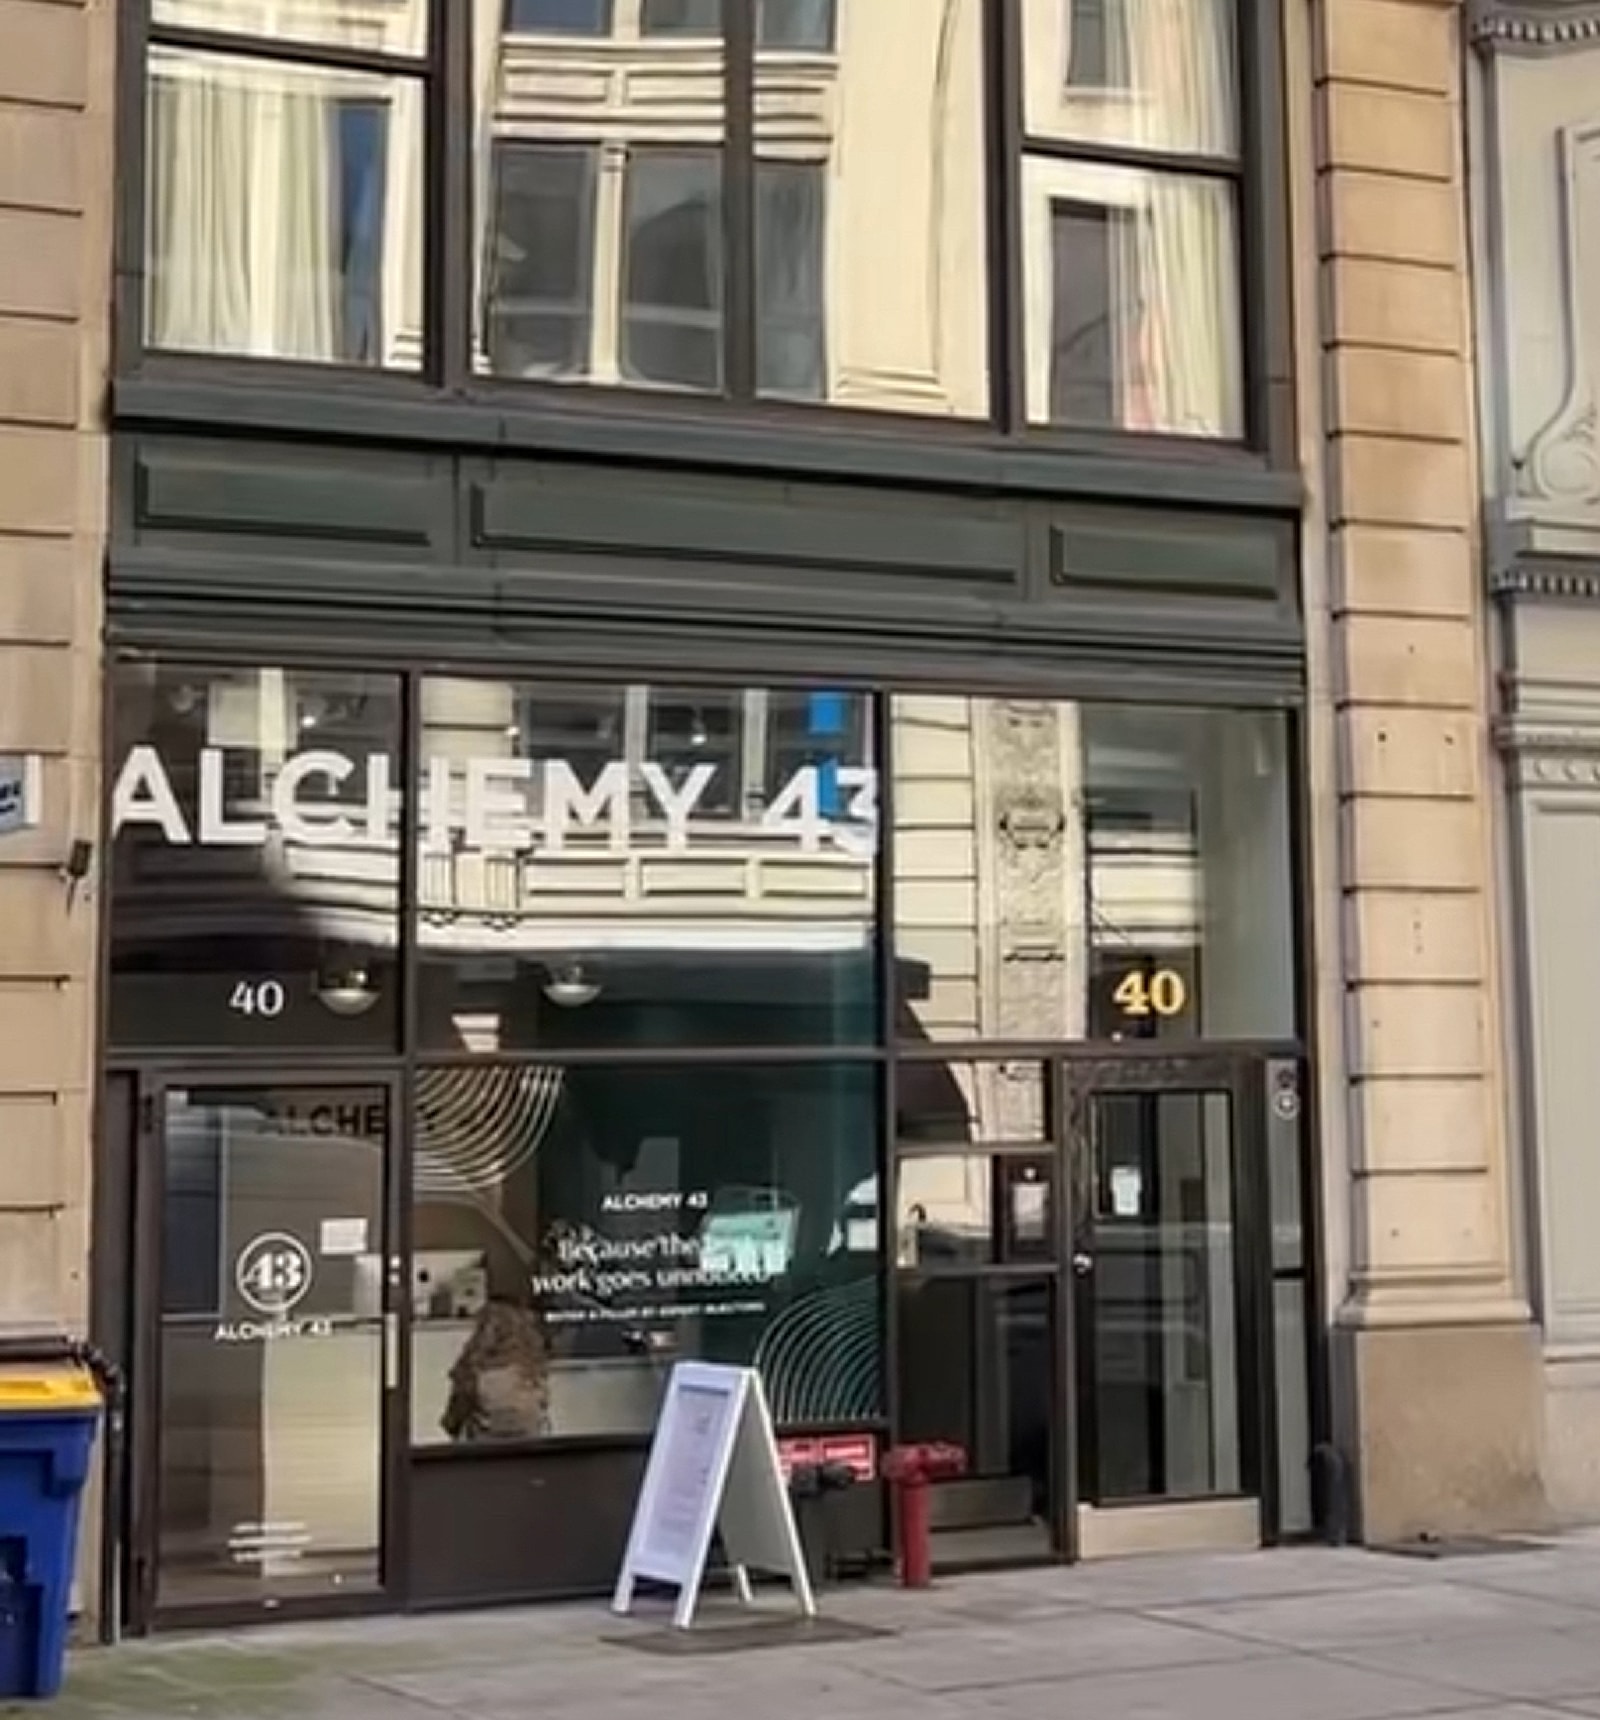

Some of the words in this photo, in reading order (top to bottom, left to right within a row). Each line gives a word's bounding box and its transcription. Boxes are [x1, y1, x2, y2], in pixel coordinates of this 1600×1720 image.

[111, 745, 717, 852] ALCHEMY
[760, 766, 878, 857] 43
[228, 979, 285, 1016] 40
[1113, 970, 1185, 1015] 40
[602, 1192, 682, 1211] ALCHEMY
[686, 1191, 708, 1208] 43
[242, 1250, 303, 1291] 43
[532, 1268, 593, 1295] work
[596, 1270, 651, 1298] goes
